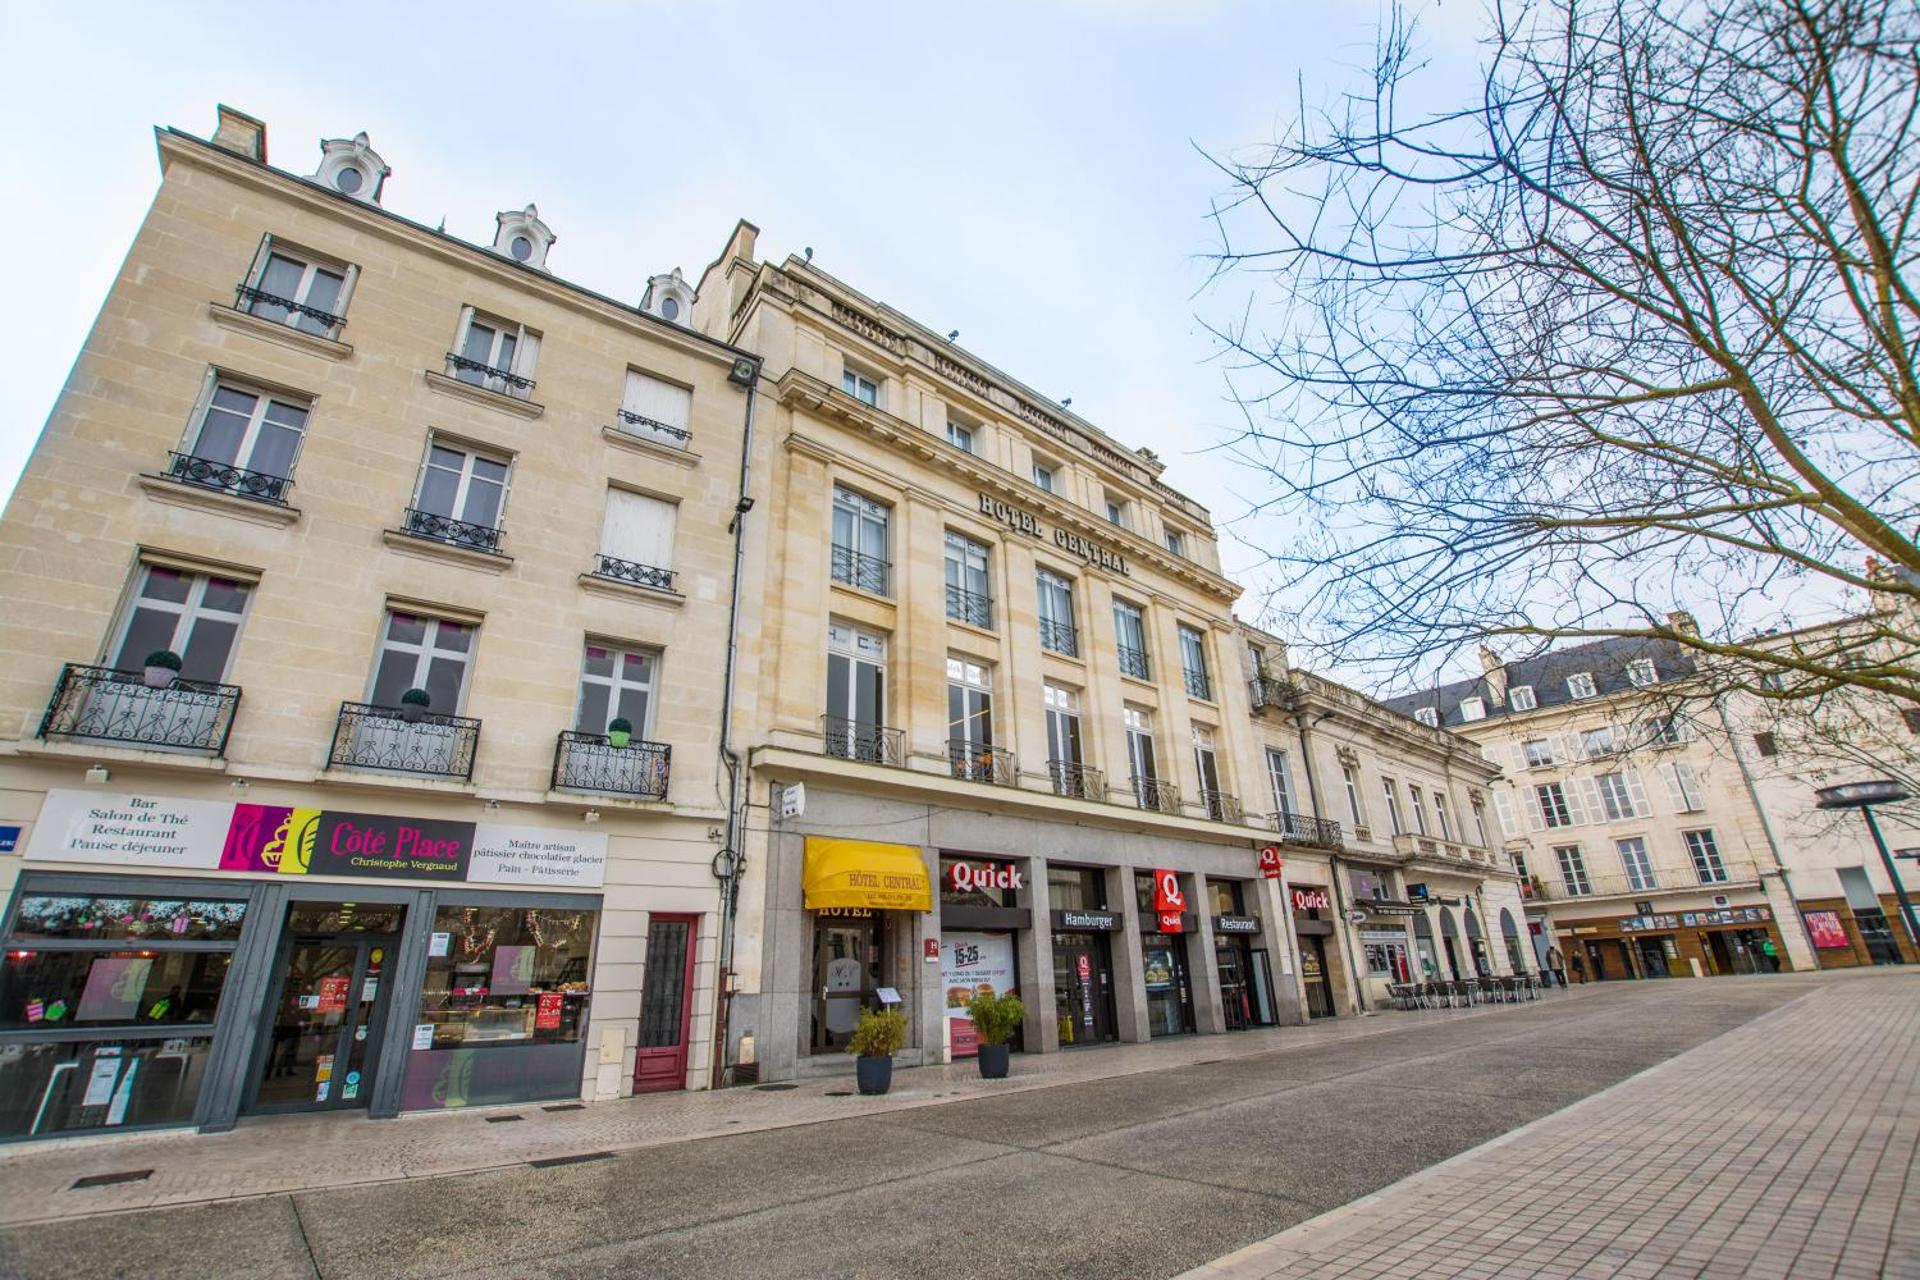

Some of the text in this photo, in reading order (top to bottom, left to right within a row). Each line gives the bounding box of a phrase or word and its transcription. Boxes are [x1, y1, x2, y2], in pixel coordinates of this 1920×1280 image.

[980, 491, 1131, 576] HOTEL CENTRAL
[130, 797, 158, 809] Bar
[88, 808, 189, 825] Salon de Thé
[92, 824, 177, 839] Restaurant
[331, 820, 461, 859] Côté Place
[70, 837, 188, 856] Pause déjeuner
[508, 839, 576, 852] Maître artisan
[351, 856, 458, 872] Christophe Vergnaud
[473, 847, 604, 865] pâtissier chocolatier glacier
[1261, 848, 1276, 865] Q
[497, 862, 521, 873] Pain
[883, 874, 922, 890] CENTRAL
[949, 862, 1023, 892] Quick
[1163, 873, 1182, 906] Q
[1296, 890, 1329, 911] Quick
[1065, 912, 1113, 930] Hamburger
[954, 945, 979, 965] 15-25
